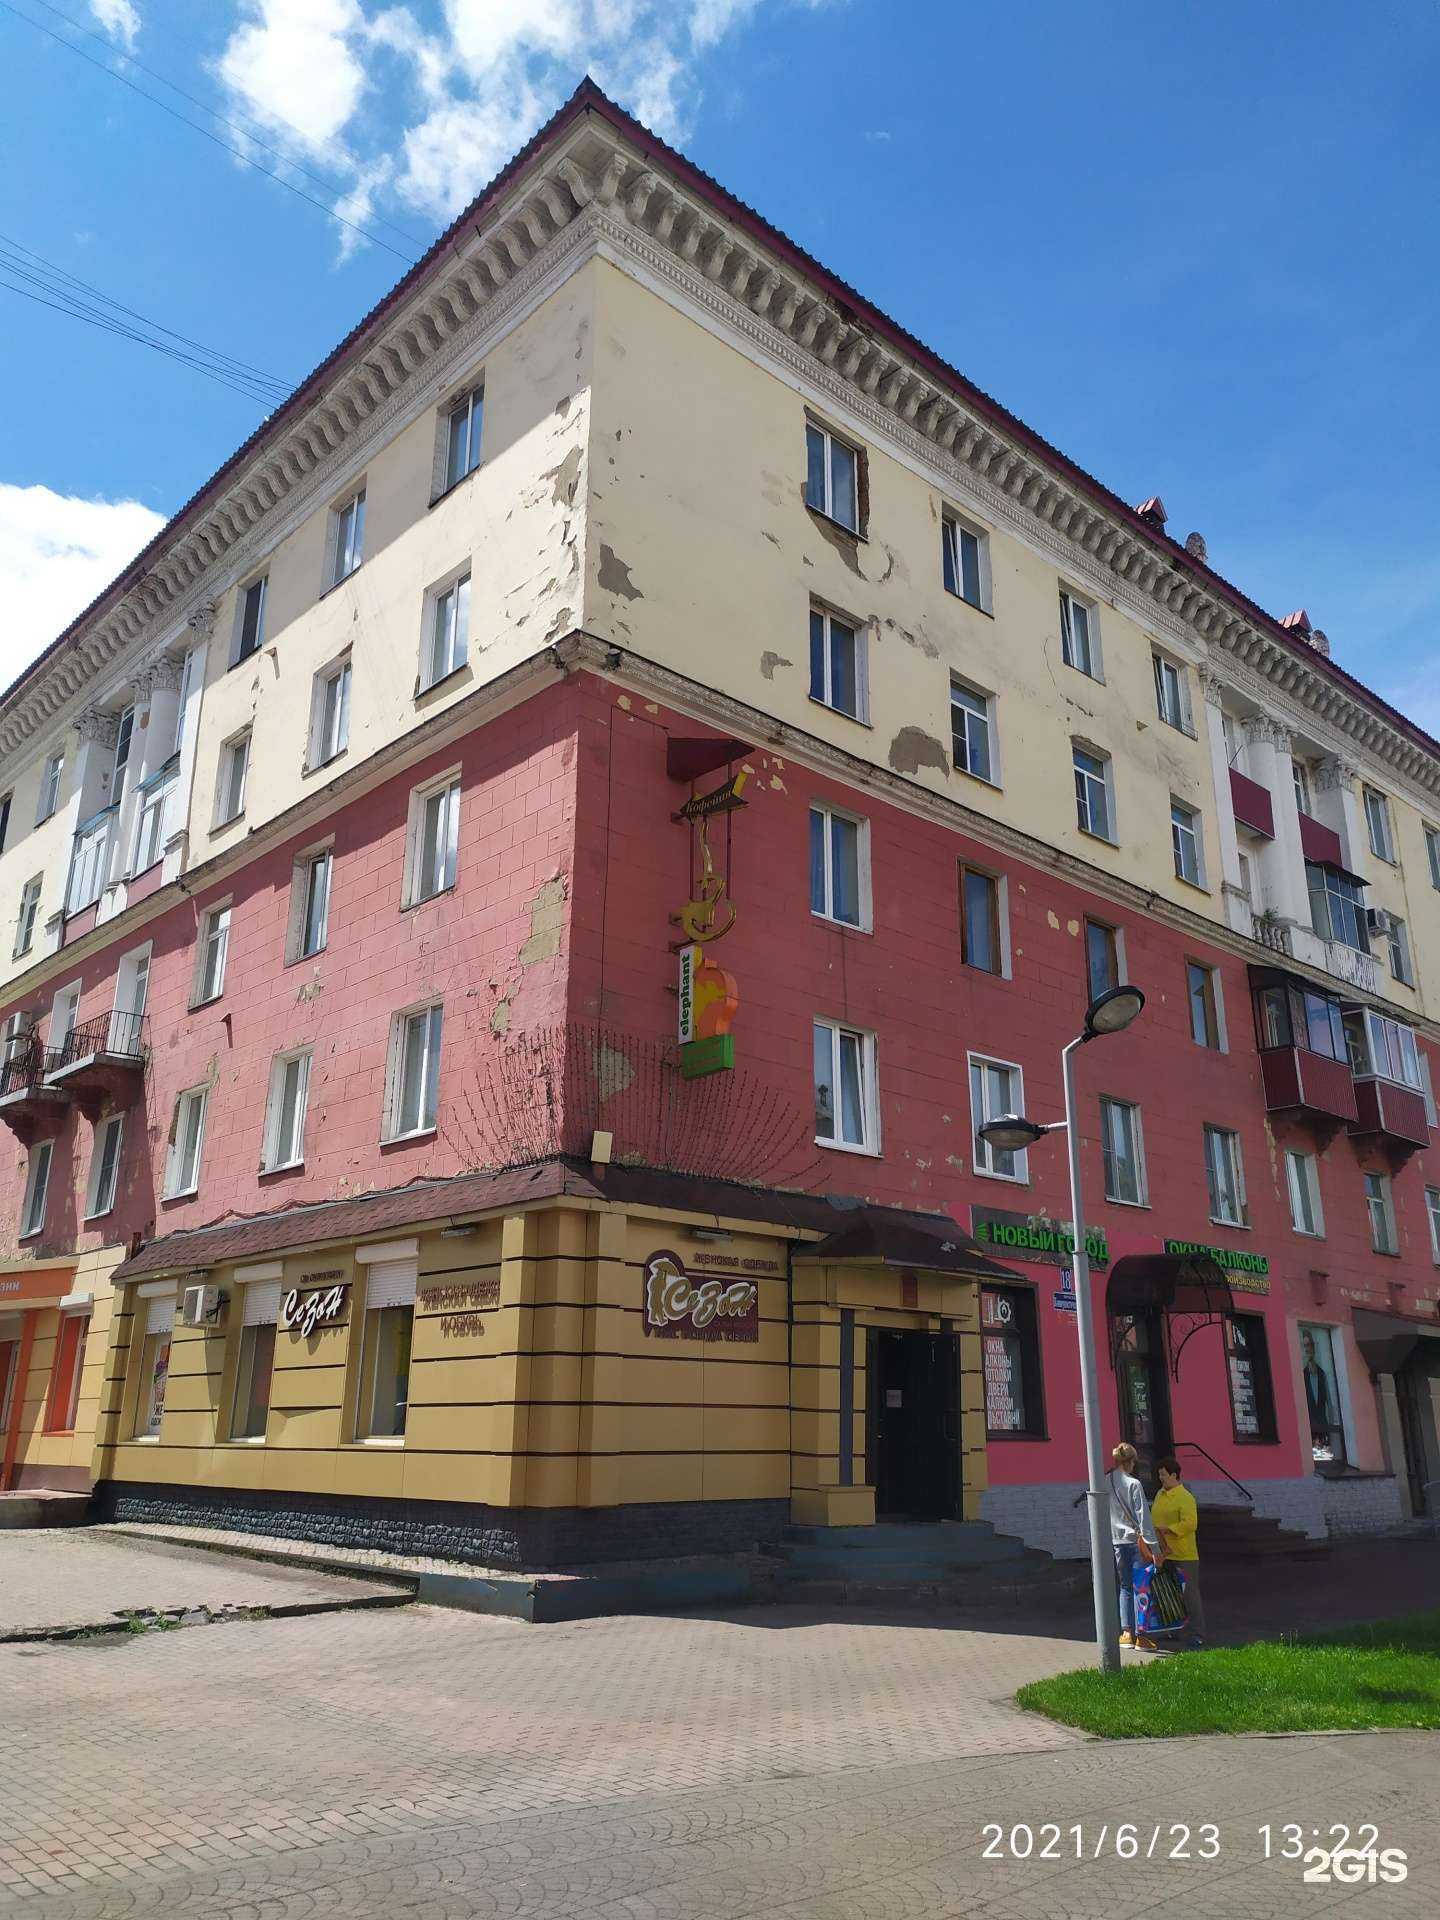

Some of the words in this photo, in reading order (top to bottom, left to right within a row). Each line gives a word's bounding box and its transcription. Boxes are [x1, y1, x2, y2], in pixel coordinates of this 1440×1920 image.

[681, 953, 691, 1036] elephant
[1058, 1234, 1110, 1262] ГООД
[985, 1353, 1012, 1368] АЛКОНЫ
